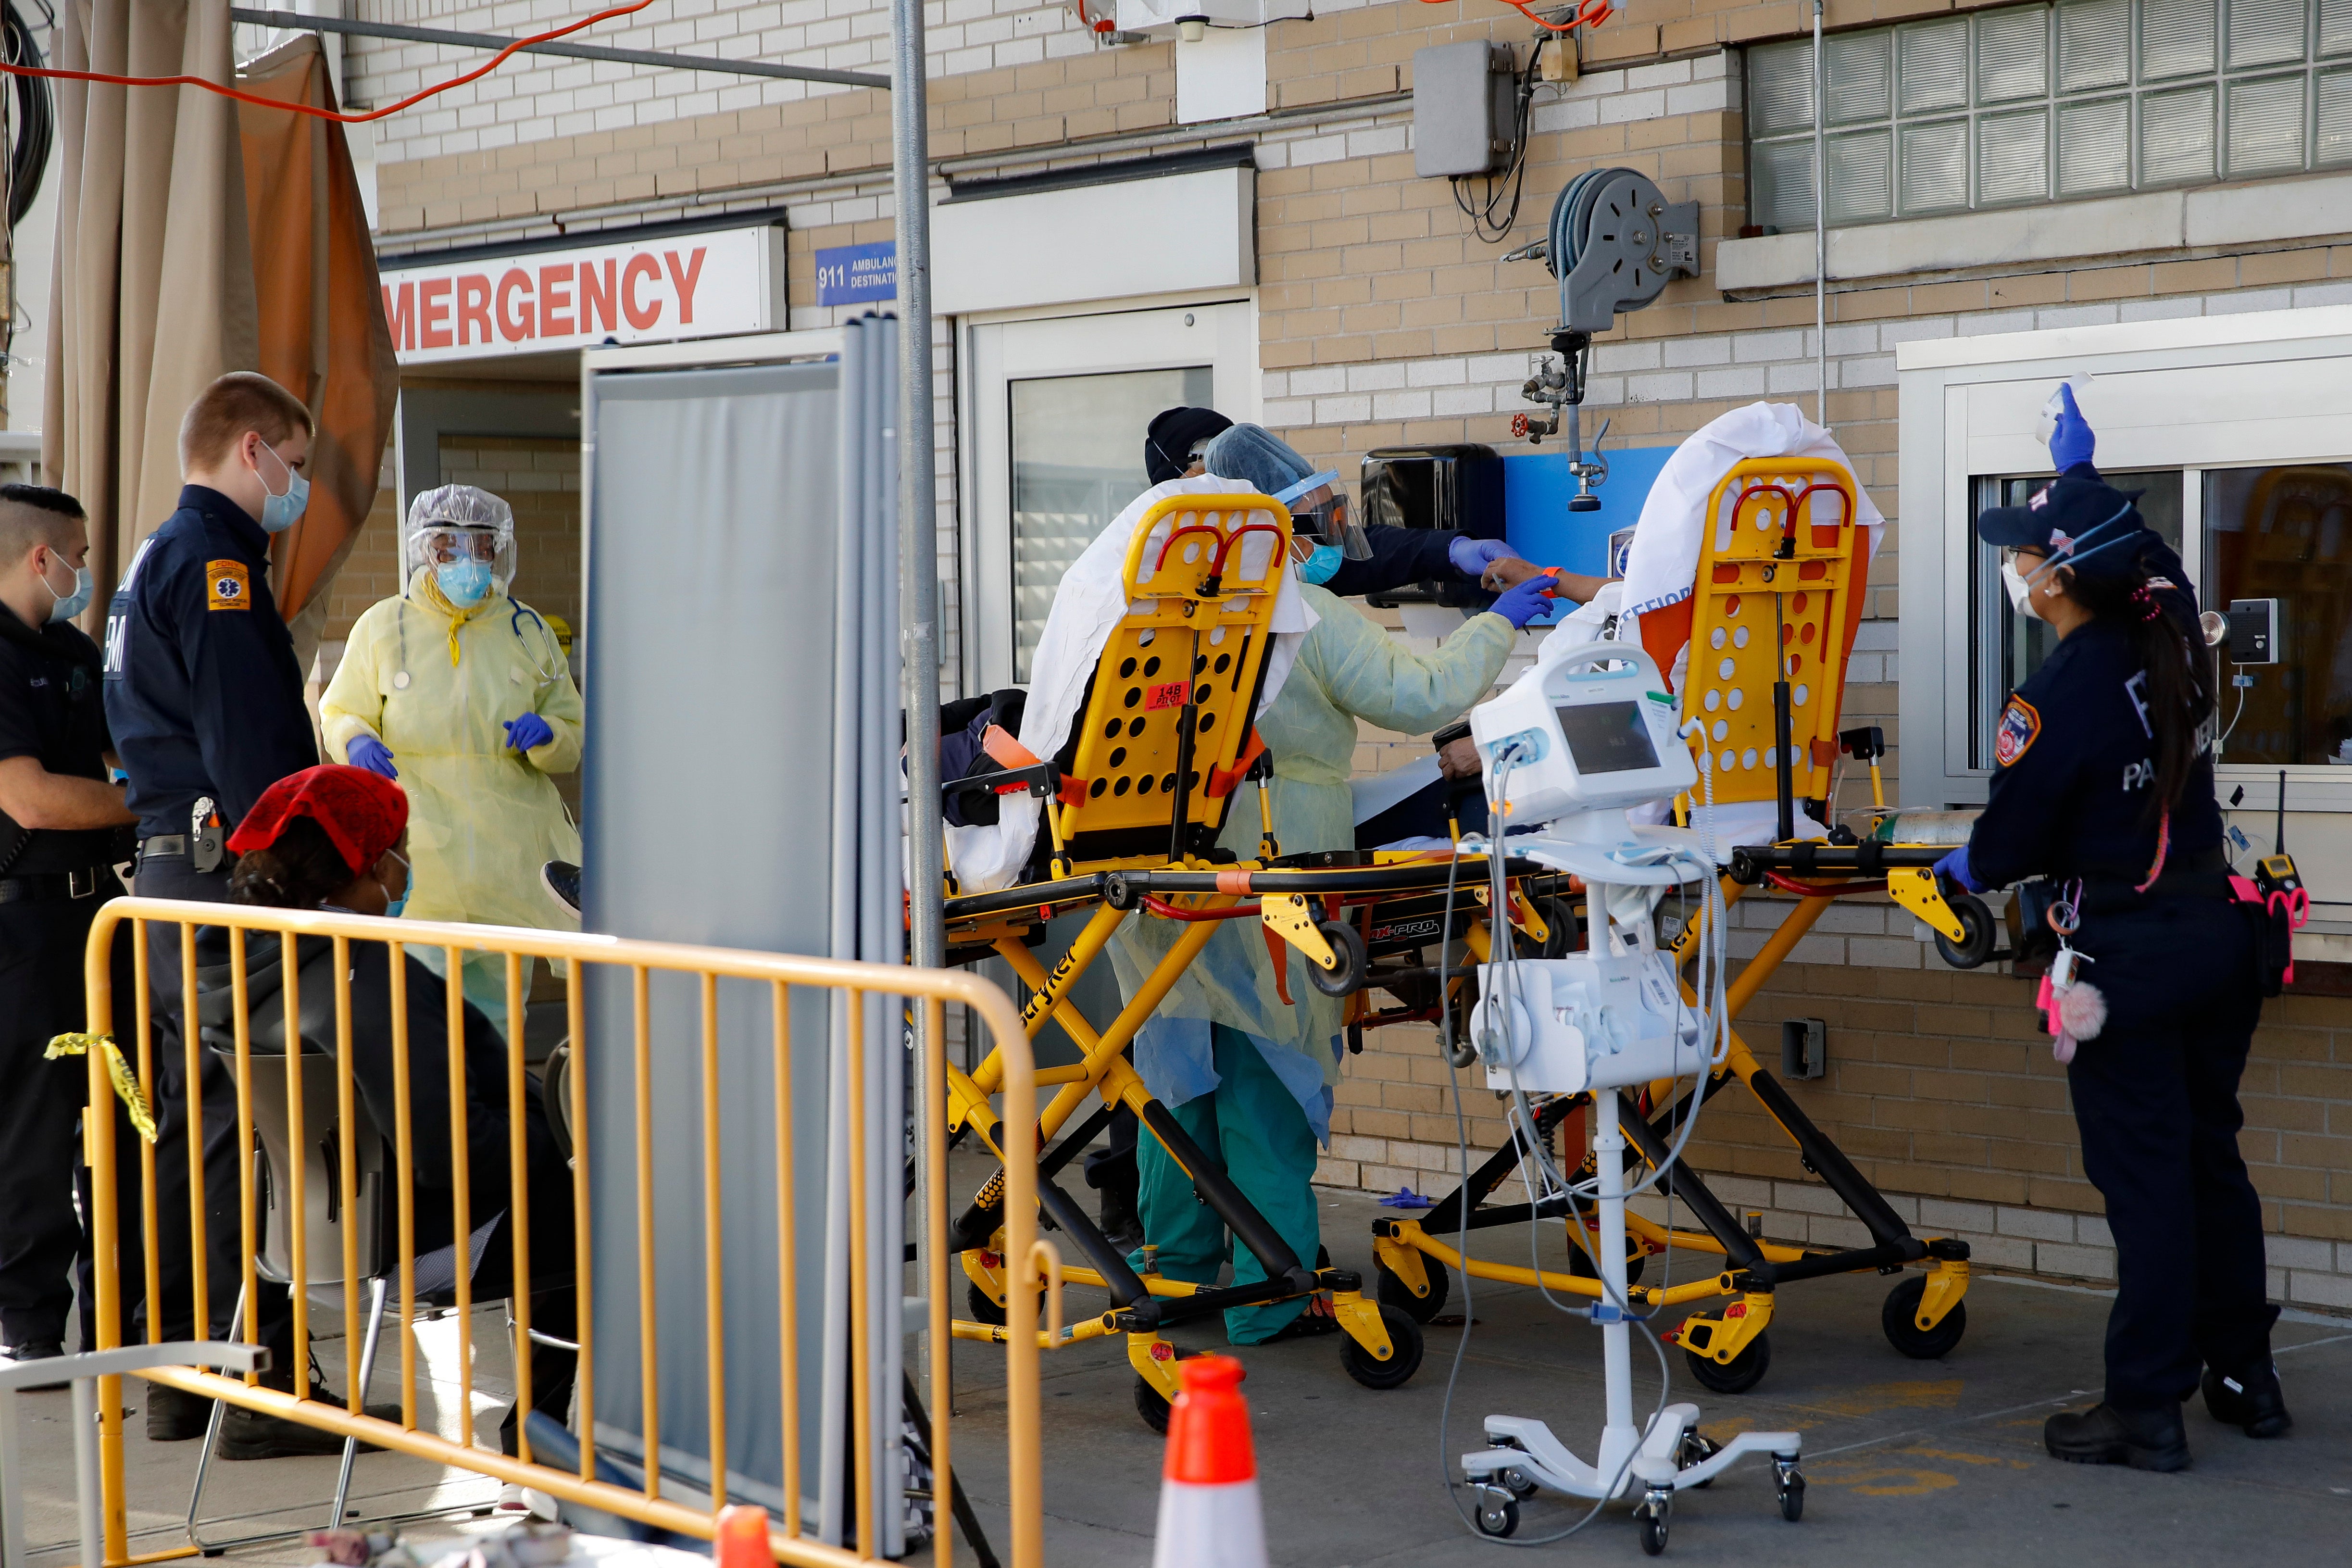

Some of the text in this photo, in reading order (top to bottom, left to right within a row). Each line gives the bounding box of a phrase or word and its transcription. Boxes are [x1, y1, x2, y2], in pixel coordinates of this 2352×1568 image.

[819, 264, 844, 288] 911
[851, 272, 897, 288] DESTINATI
[1159, 685, 1181, 698] 14B
